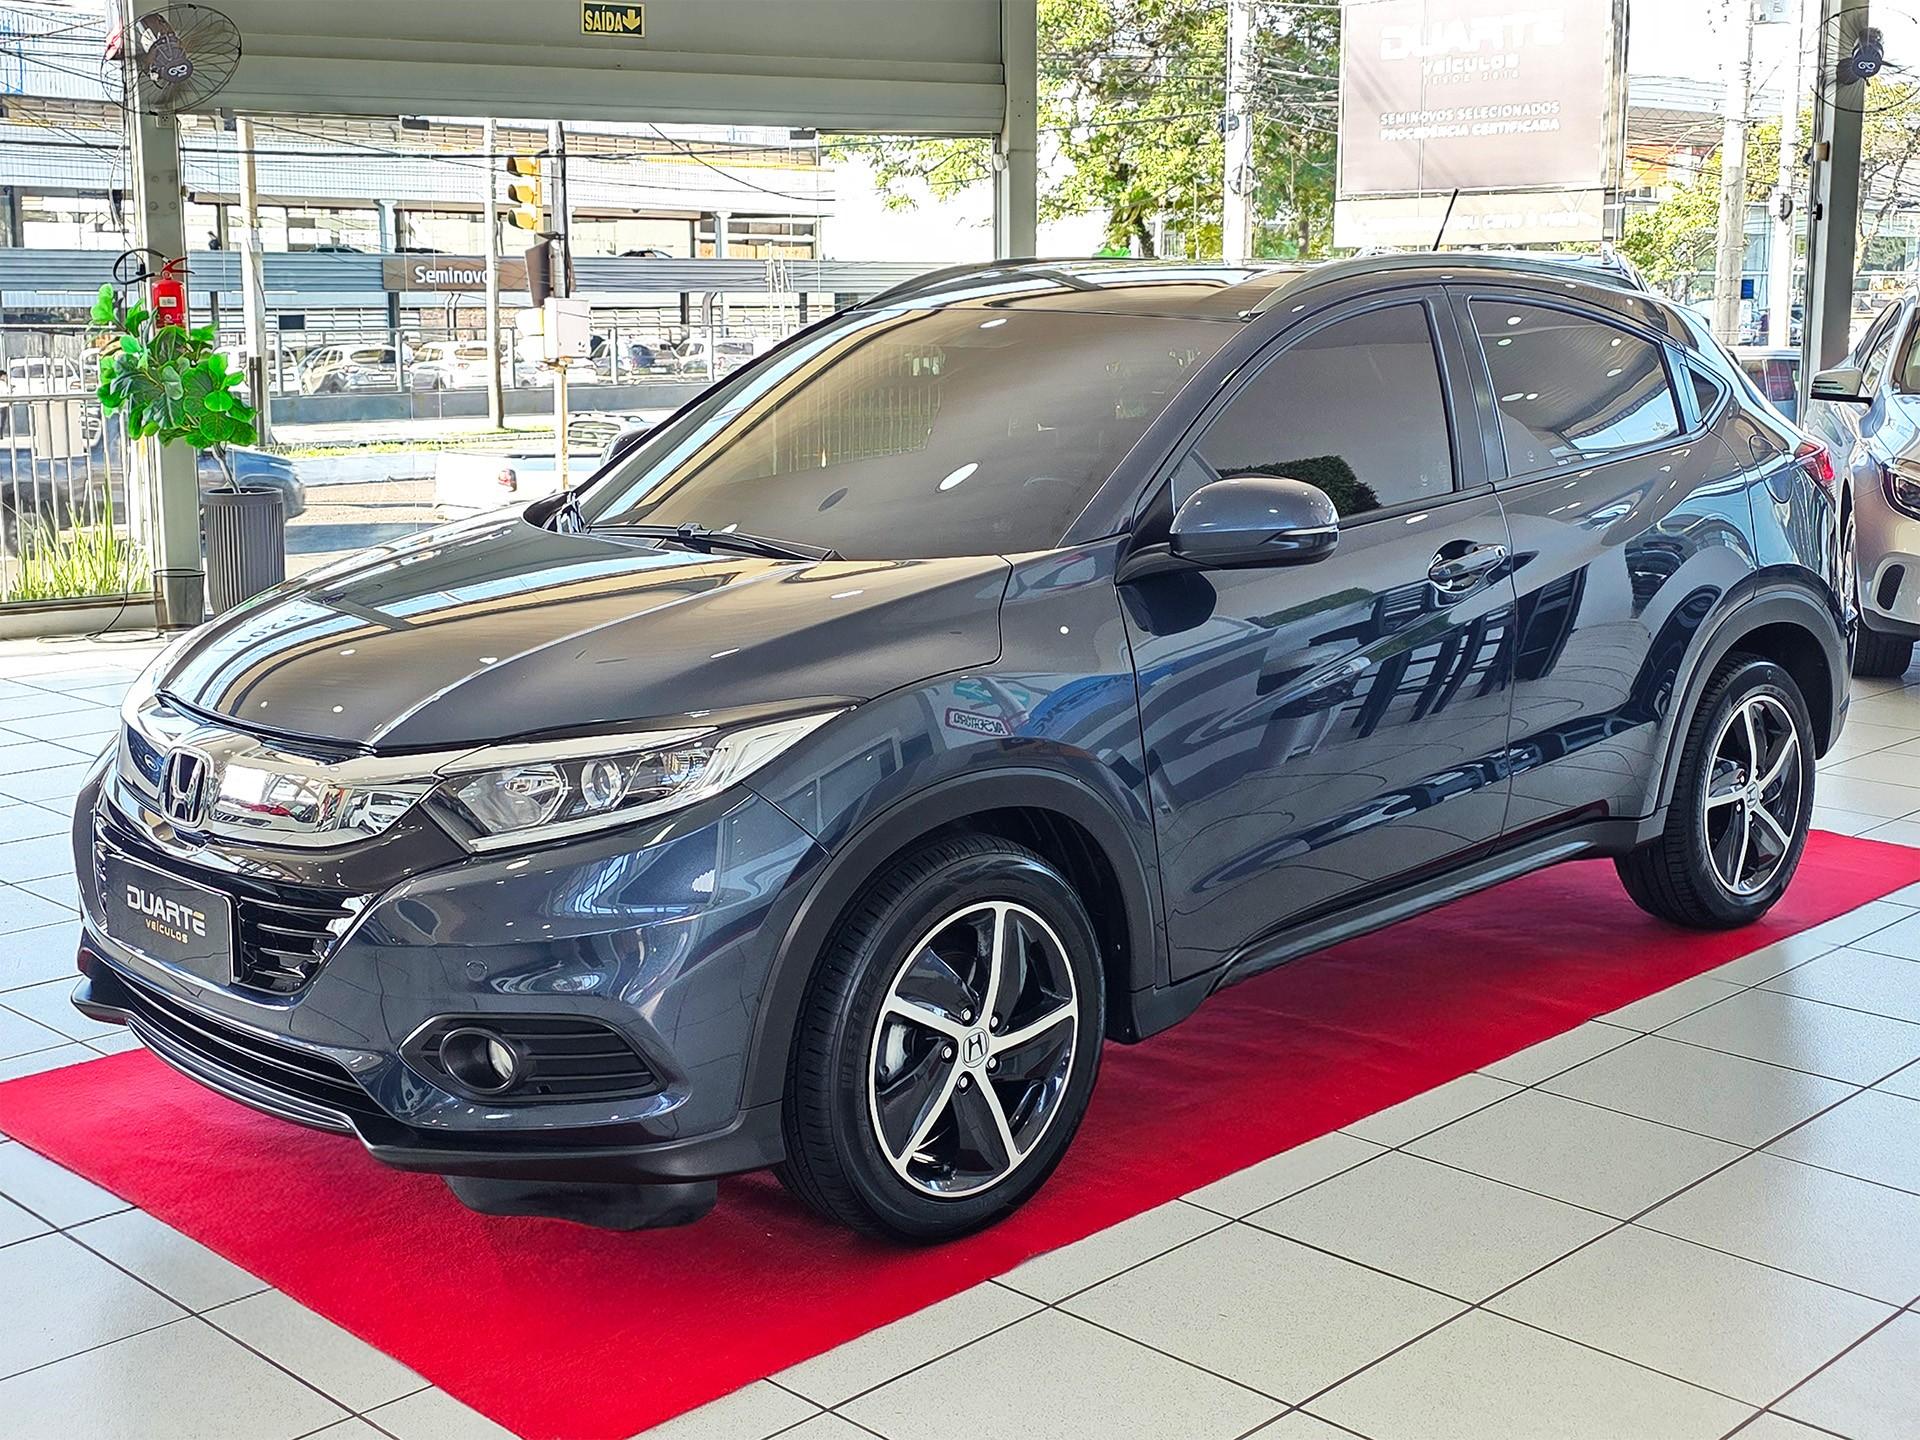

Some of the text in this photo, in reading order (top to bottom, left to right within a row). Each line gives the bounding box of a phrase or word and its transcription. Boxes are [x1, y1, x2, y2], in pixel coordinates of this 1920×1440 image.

[585, 5, 623, 32] SAÍDA
[1456, 101, 1561, 120] SELECIONADOS
[126, 884, 206, 937] DUARTE
